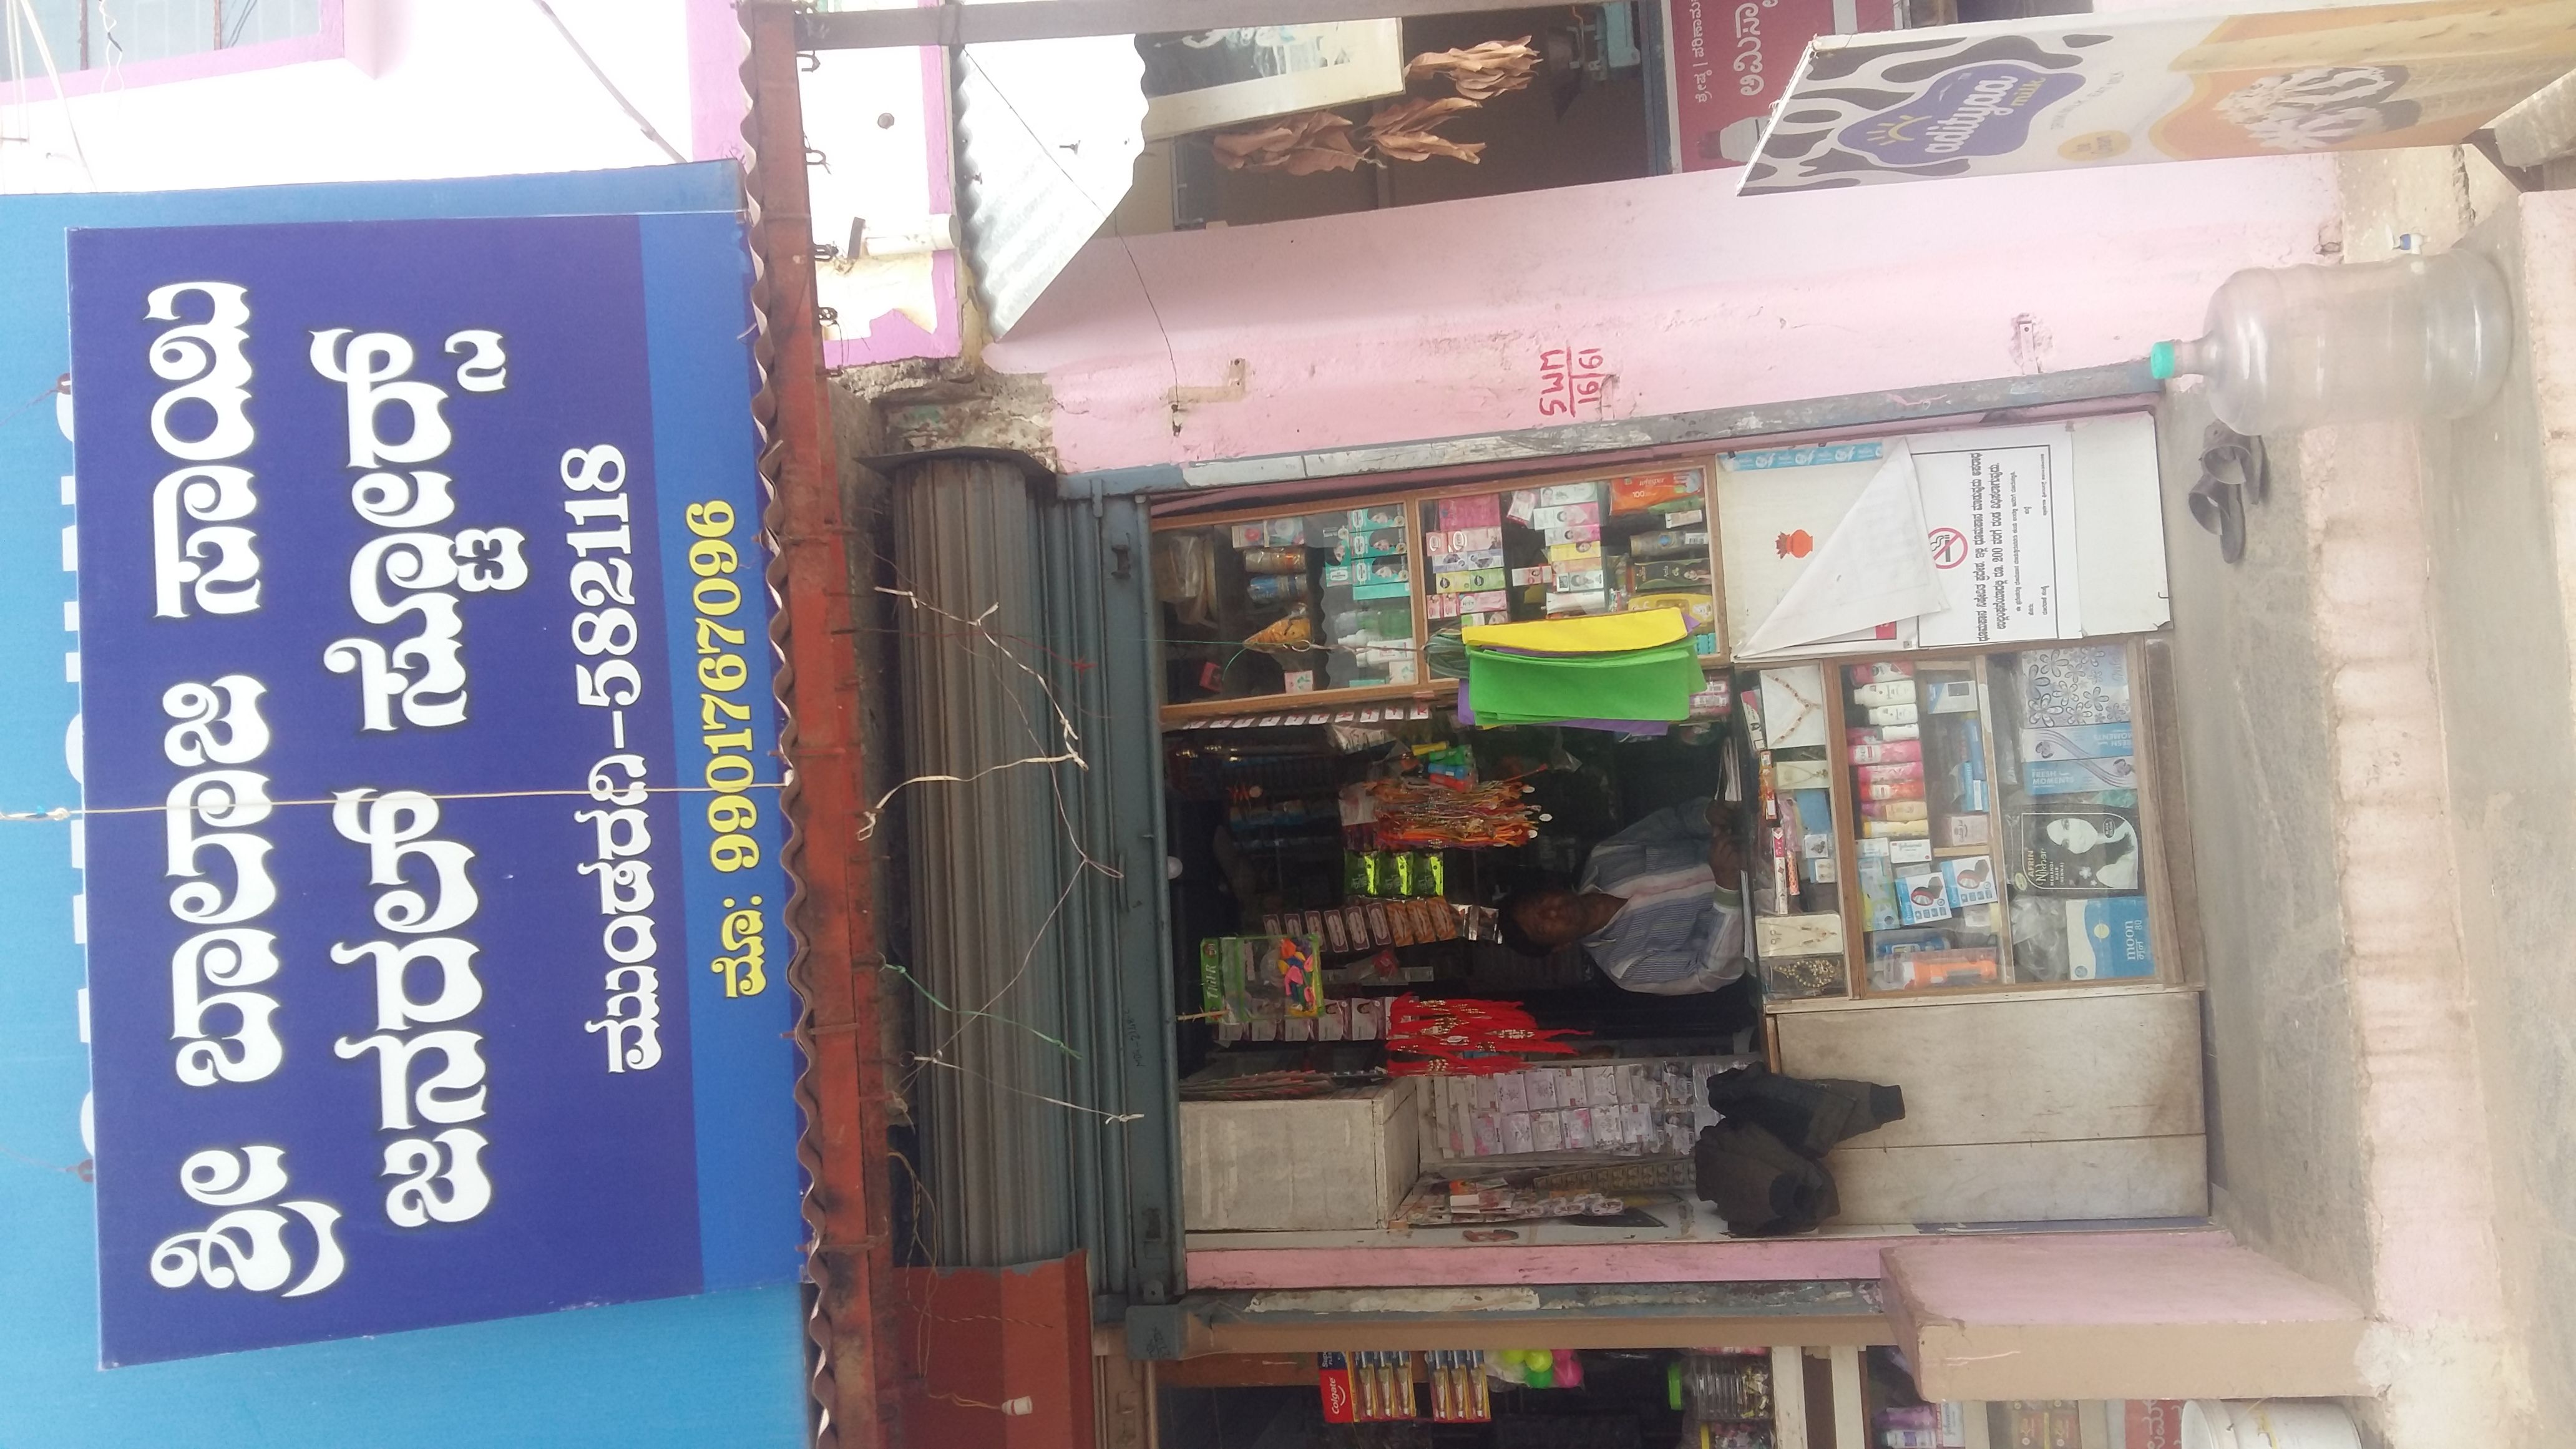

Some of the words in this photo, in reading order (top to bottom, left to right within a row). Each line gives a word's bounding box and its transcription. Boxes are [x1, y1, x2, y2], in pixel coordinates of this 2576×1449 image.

[1689, 0, 1704, 58] ಪರಿಣಾಮ
[2010, 77, 2046, 106] milk
[1924, 76, 2019, 154] adityaa
[1578, 348, 1603, 369] 61
[1539, 349, 1567, 416] SWM
[1577, 381, 1599, 404] 16
[143, 281, 261, 618] ಸಾಯಿ
[1639, 477, 1666, 486] whisper
[308, 328, 529, 731] ಸ್ಟೋರ್ಸ್
[1971, 514, 1986, 545] ಧೂಮಪಾನ
[1991, 547, 2003, 562] 200
[1975, 610, 1990, 642] ಧೂಮಪಾನ
[685, 500, 761, 872] 9901767096
[162, 675, 283, 1086] ಬಾಲಾಜಿ
[2035, 848, 2049, 885] Nikhar
[2124, 920, 2135, 960] moon
[2135, 920, 2143, 930] 80
[710, 895, 767, 998] ಮೊ:
[330, 788, 492, 1227] ಜನರಲ್
[150, 1145, 344, 1297] ಶ್ರೀ
[1328, 1377, 1340, 1414] Colgate
